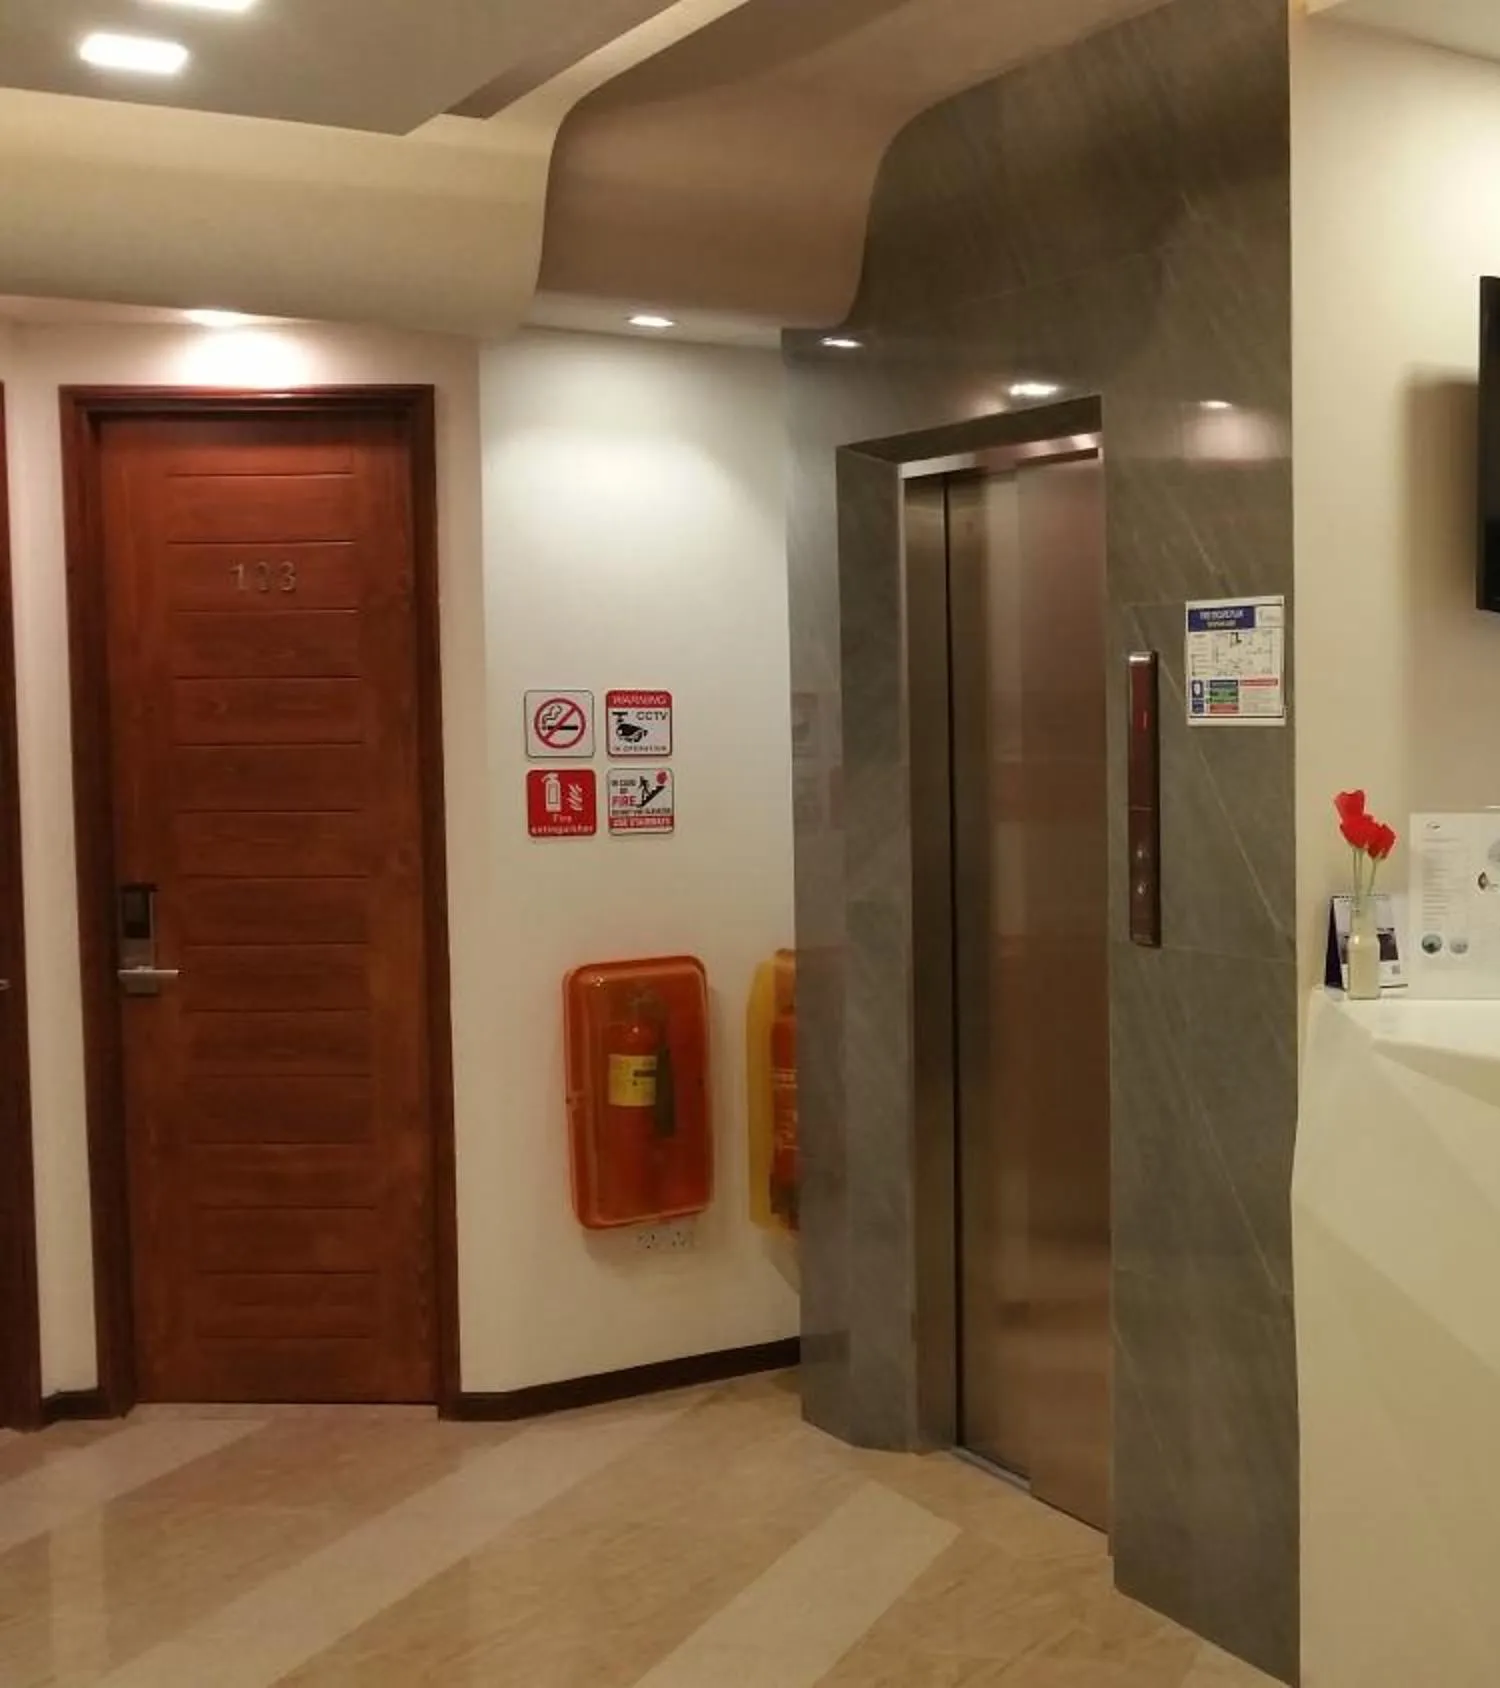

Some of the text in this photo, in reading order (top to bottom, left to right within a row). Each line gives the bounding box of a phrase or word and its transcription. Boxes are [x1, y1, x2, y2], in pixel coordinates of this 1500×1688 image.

[229, 561, 297, 592] 103
[613, 695, 667, 705] WARNING
[636, 711, 668, 721] CCTV
